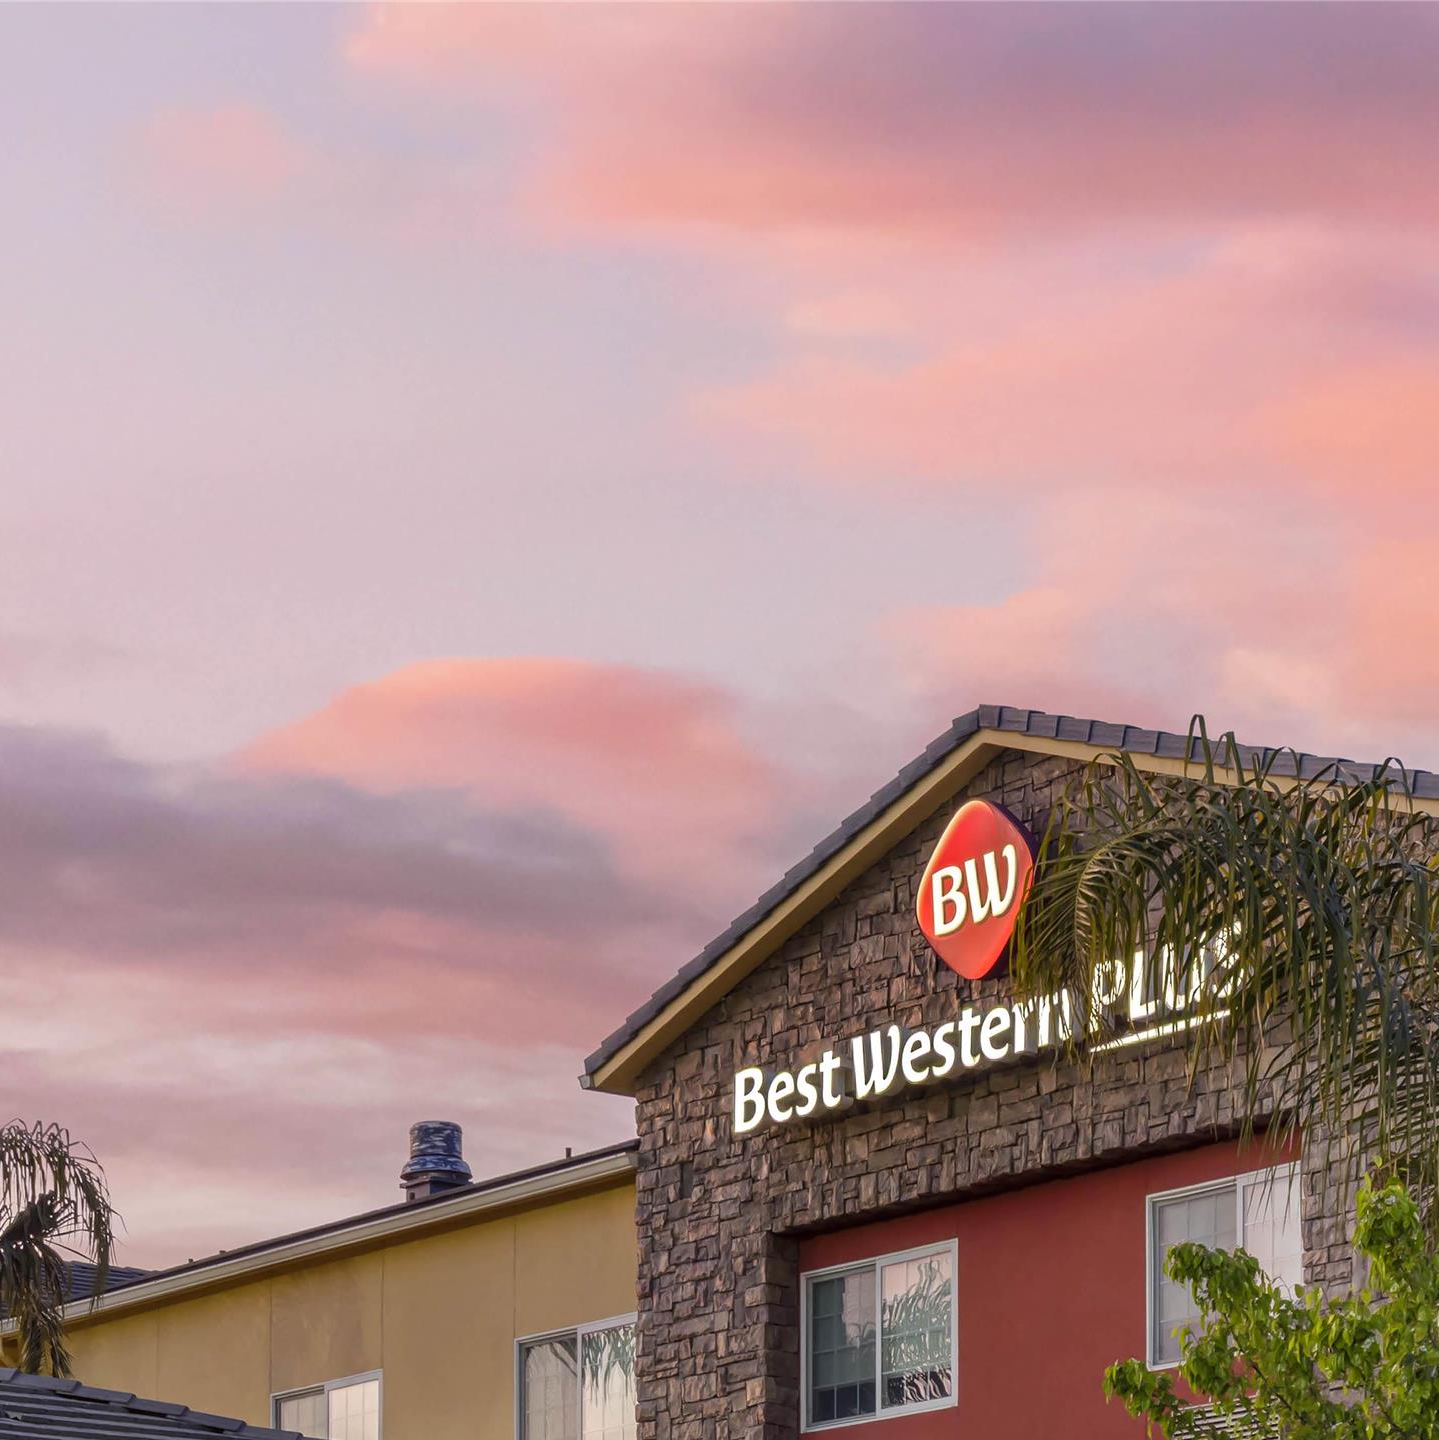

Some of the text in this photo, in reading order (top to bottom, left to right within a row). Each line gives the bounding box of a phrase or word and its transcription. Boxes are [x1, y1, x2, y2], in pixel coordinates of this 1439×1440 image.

[931, 843, 1018, 936] BW
[733, 1053, 842, 1134] Best
[851, 988, 1073, 1099] Western
